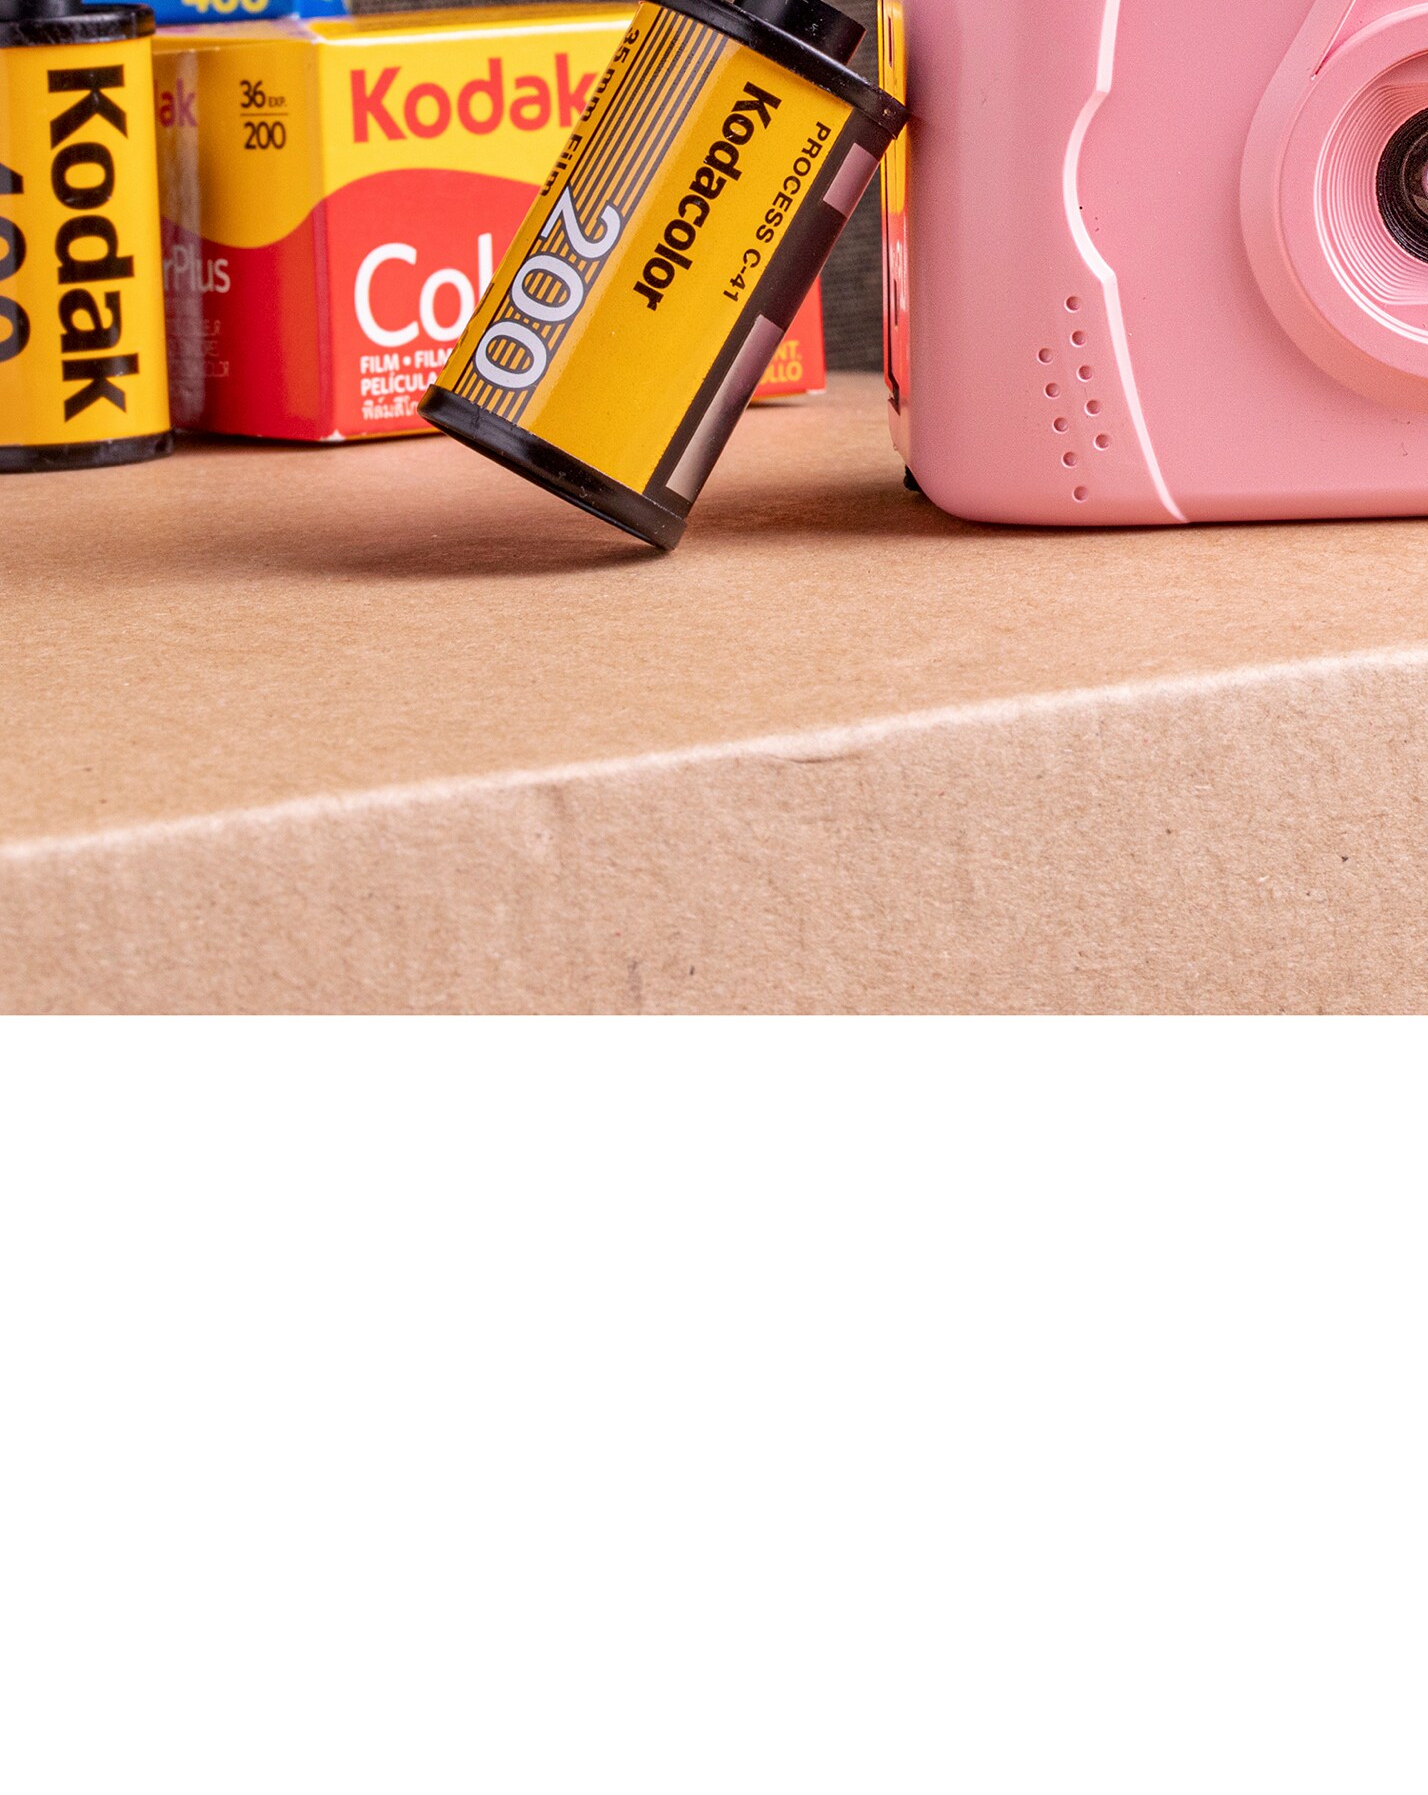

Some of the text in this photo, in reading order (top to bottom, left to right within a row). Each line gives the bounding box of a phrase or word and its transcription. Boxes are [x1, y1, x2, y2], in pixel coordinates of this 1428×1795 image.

[154, 78, 197, 128] ak
[240, 79, 266, 108] 36
[244, 121, 287, 149] 200
[351, 53, 598, 143] Kodak
[540, 27, 640, 196] 35 mm Film
[47, 64, 139, 422] Kodak
[633, 81, 782, 311] Kodacolor
[724, 122, 831, 302] PROCESS C-41
[475, 186, 621, 388] 200
[361, 353, 399, 374] FILM
